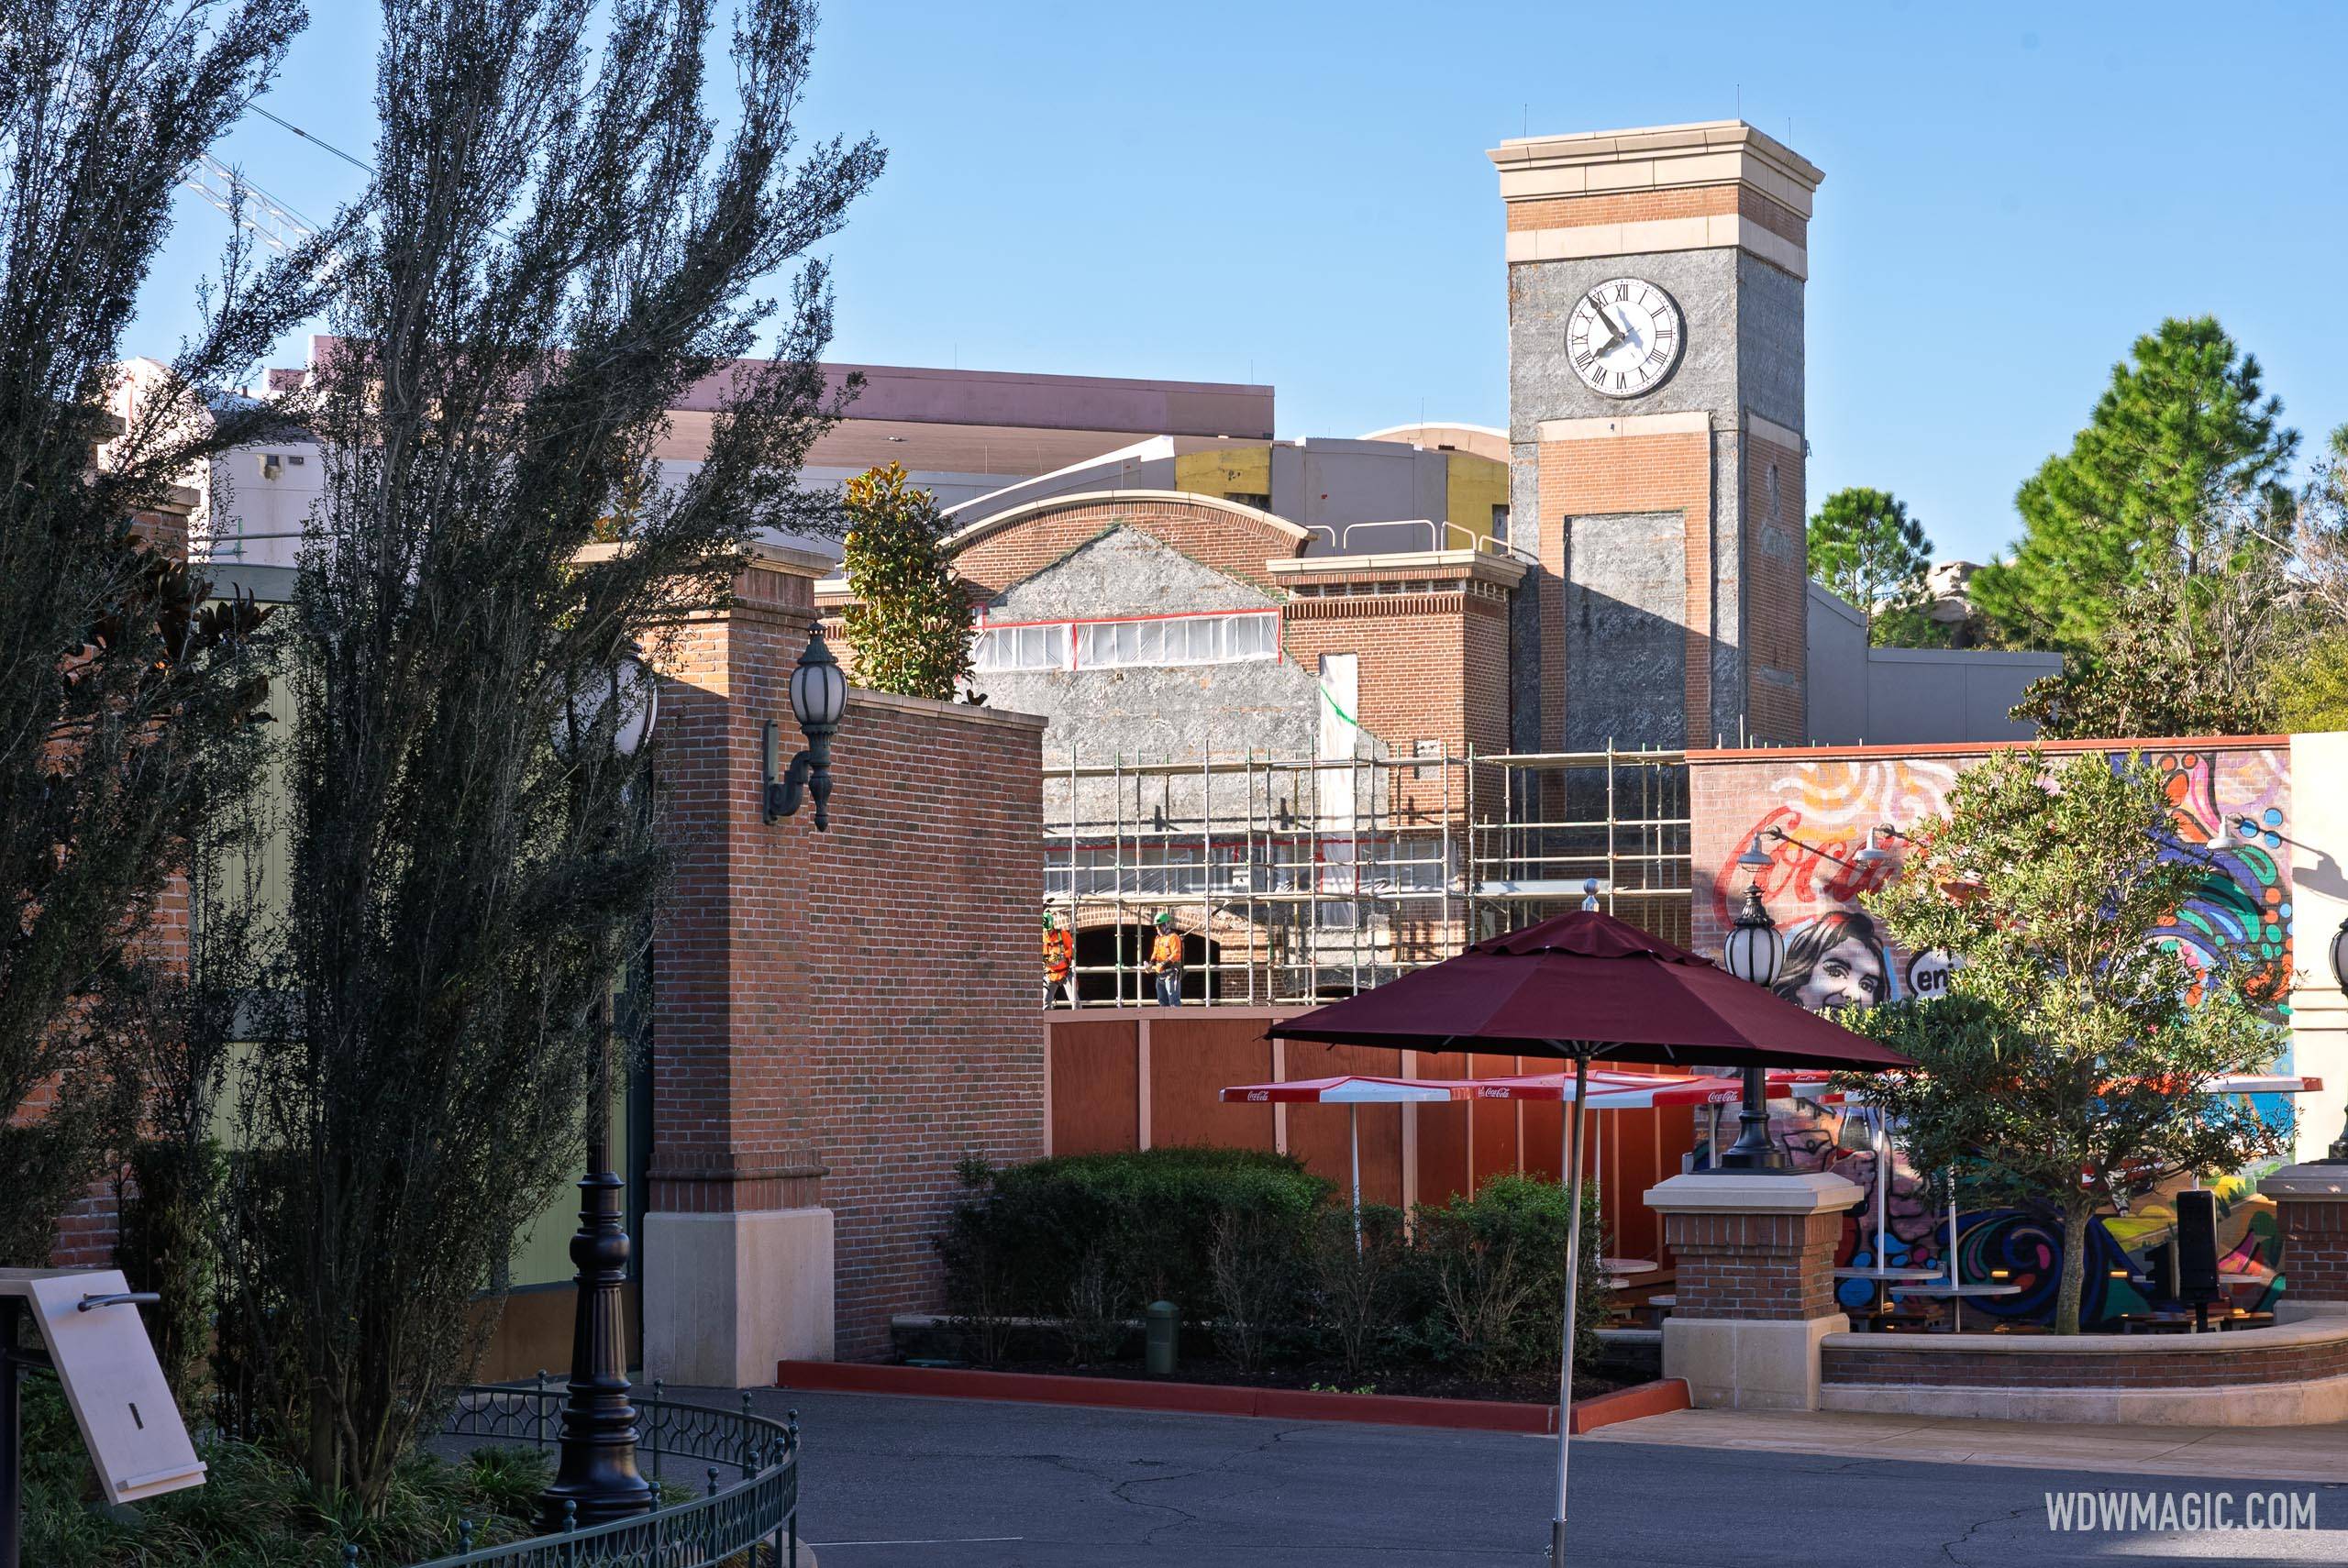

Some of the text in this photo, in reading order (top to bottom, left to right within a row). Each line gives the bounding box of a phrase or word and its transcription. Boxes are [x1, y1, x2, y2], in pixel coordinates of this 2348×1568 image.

[1615, 284, 1629, 302] XII
[1638, 289, 1648, 305] I
[1578, 310, 1594, 324] X
[1650, 305, 1667, 318] II
[1571, 334, 1588, 346] IX
[1655, 329, 1673, 339] III
[1575, 350, 1595, 372] VIII
[1591, 366, 1608, 387] VII
[1616, 371, 1627, 390] VI
[1637, 366, 1650, 382] V
